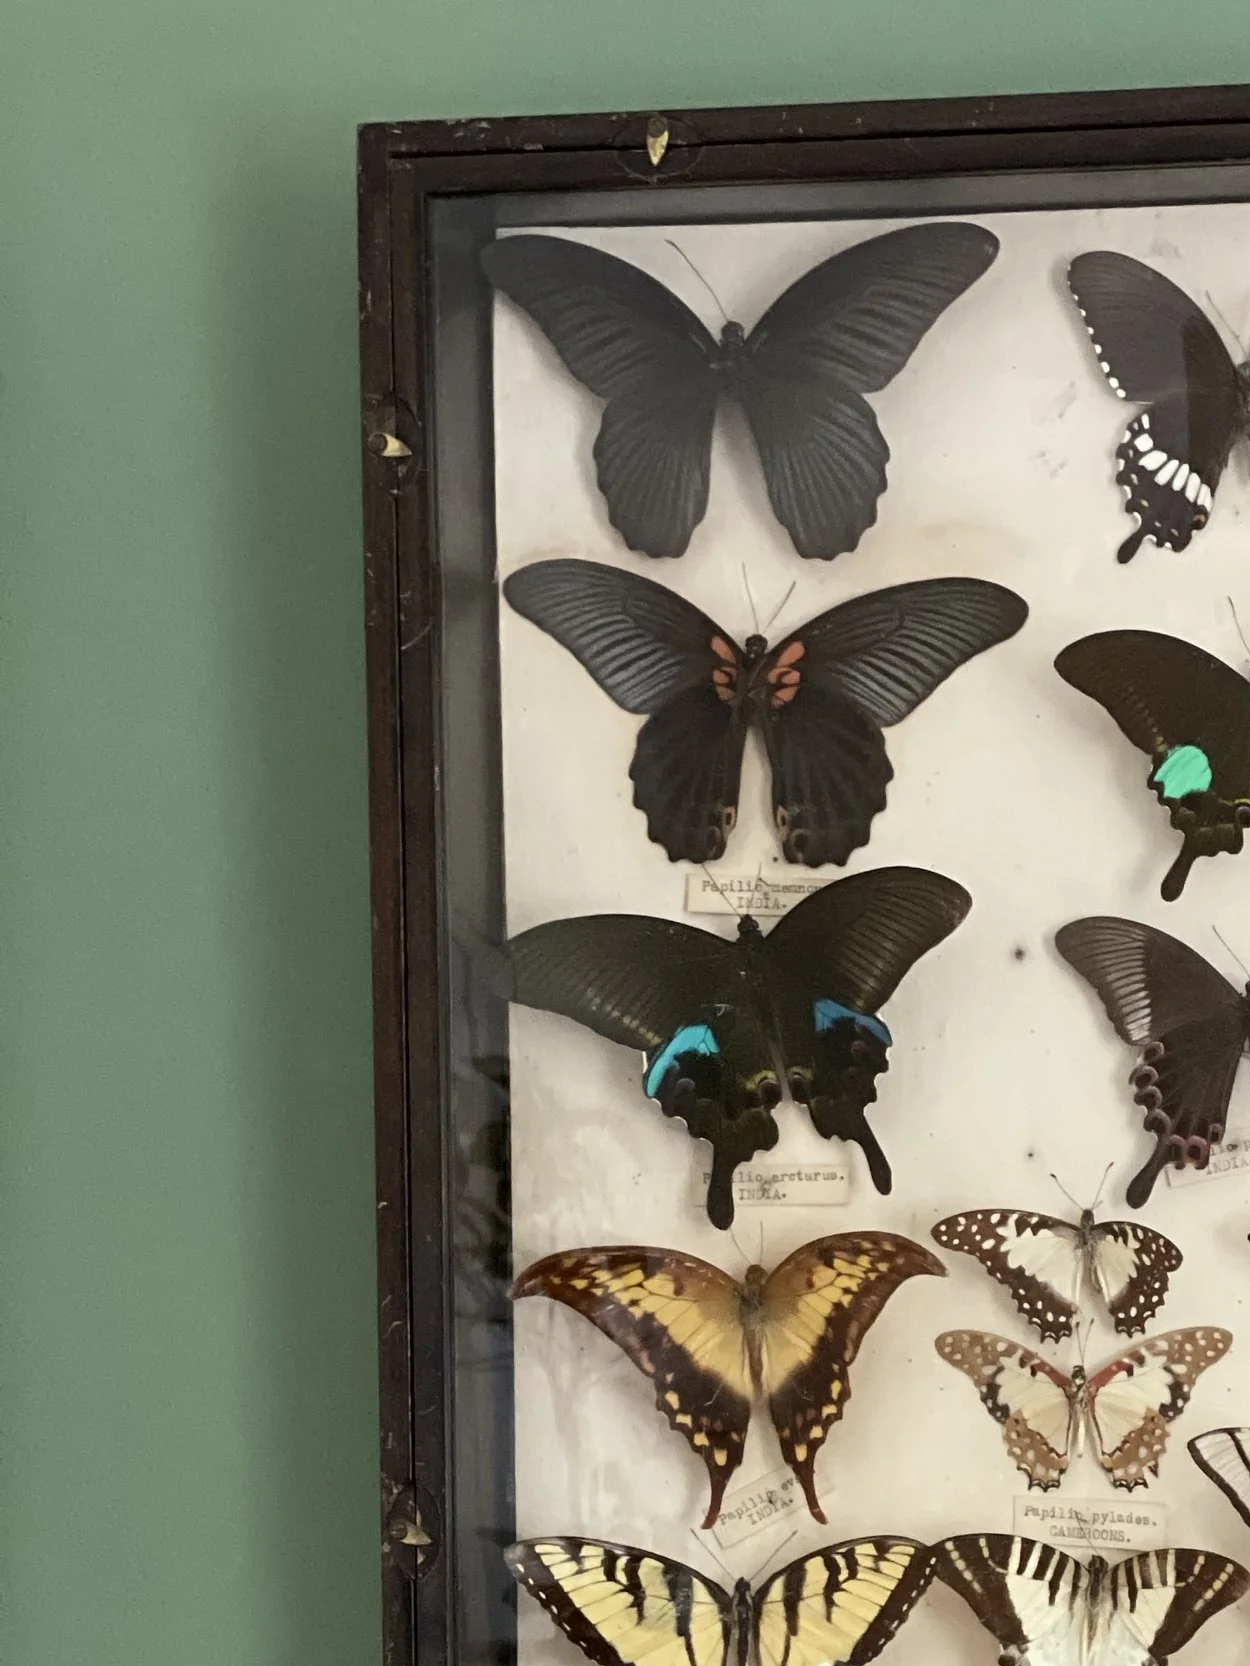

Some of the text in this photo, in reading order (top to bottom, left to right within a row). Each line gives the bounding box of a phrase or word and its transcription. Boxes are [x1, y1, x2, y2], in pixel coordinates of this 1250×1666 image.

[702, 879, 764, 898] Papilio
[737, 896, 788, 910] INDIA.
[703, 1170, 845, 1184] Plio arcturus.
[738, 1188, 787, 1201] INDIA.
[718, 1487, 776, 1526] Papilio
[747, 1497, 794, 1526] INDIA.
[1024, 1504, 1158, 1527] Papilio pylades.
[1049, 1524, 1133, 1543] CAMEROONS.
